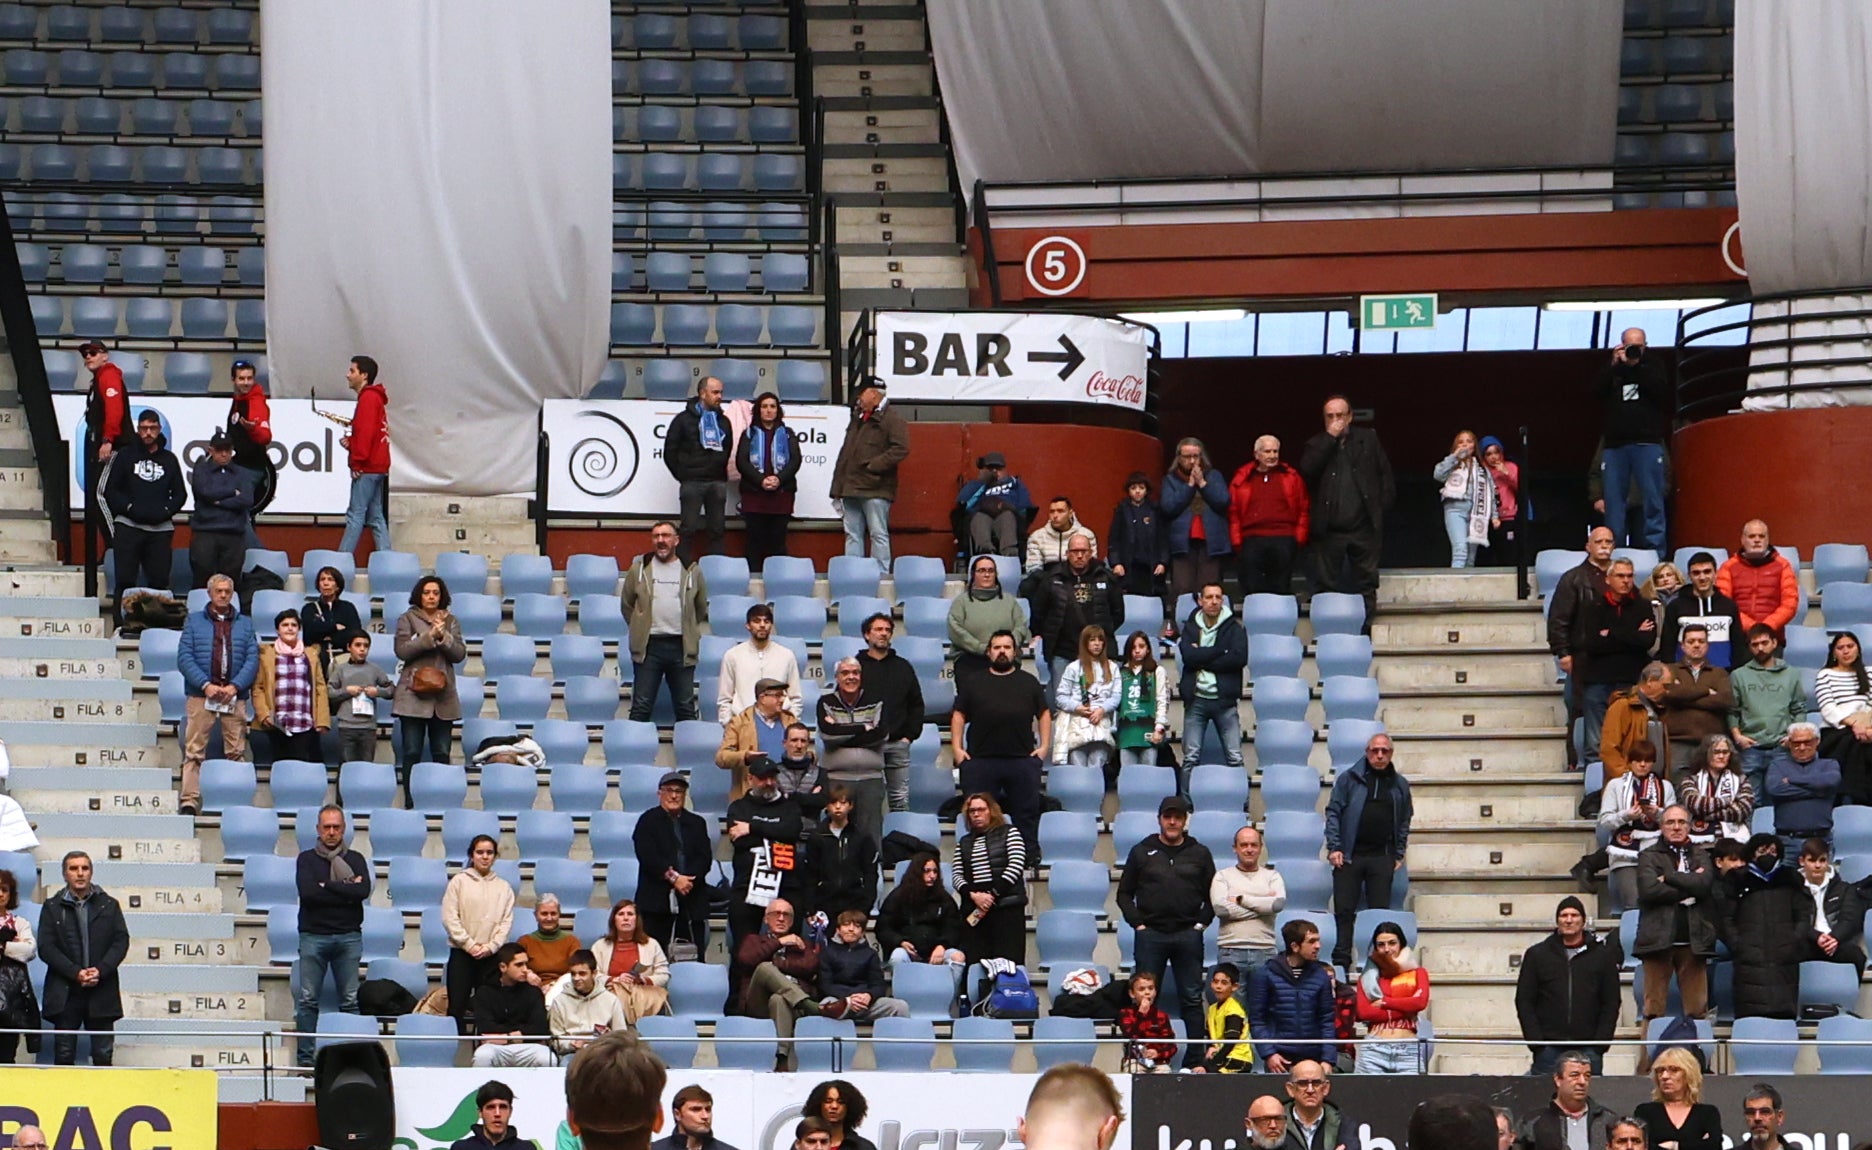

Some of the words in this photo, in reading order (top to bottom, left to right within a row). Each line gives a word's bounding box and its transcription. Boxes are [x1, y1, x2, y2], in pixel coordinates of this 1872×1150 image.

[1043, 249, 1067, 283] 5
[892, 331, 1013, 378] BAR
[0, 413, 11, 424] 12
[13, 472, 25, 482] 11
[44, 621, 71, 633] FILA
[79, 623, 92, 634] 10
[372, 623, 385, 634] 12
[60, 663, 87, 675] FILA
[96, 664, 105, 675] 9
[127, 660, 135, 671] 8
[1128, 685, 1141, 700] 26
[77, 704, 104, 716] FILA
[115, 705, 124, 716] 8
[99, 749, 127, 762] FILA
[137, 750, 145, 762] 7
[114, 795, 142, 807] FILA
[152, 797, 160, 808] 6
[155, 891, 184, 904] FILA
[193, 892, 202, 904] 4
[236, 886, 244, 898] 7
[174, 943, 204, 956] FILA
[216, 944, 225, 956] 3
[249, 937, 257, 949] 7
[196, 998, 226, 1011] FILA
[237, 998, 246, 1011] 2
[218, 1052, 250, 1065] FILA
